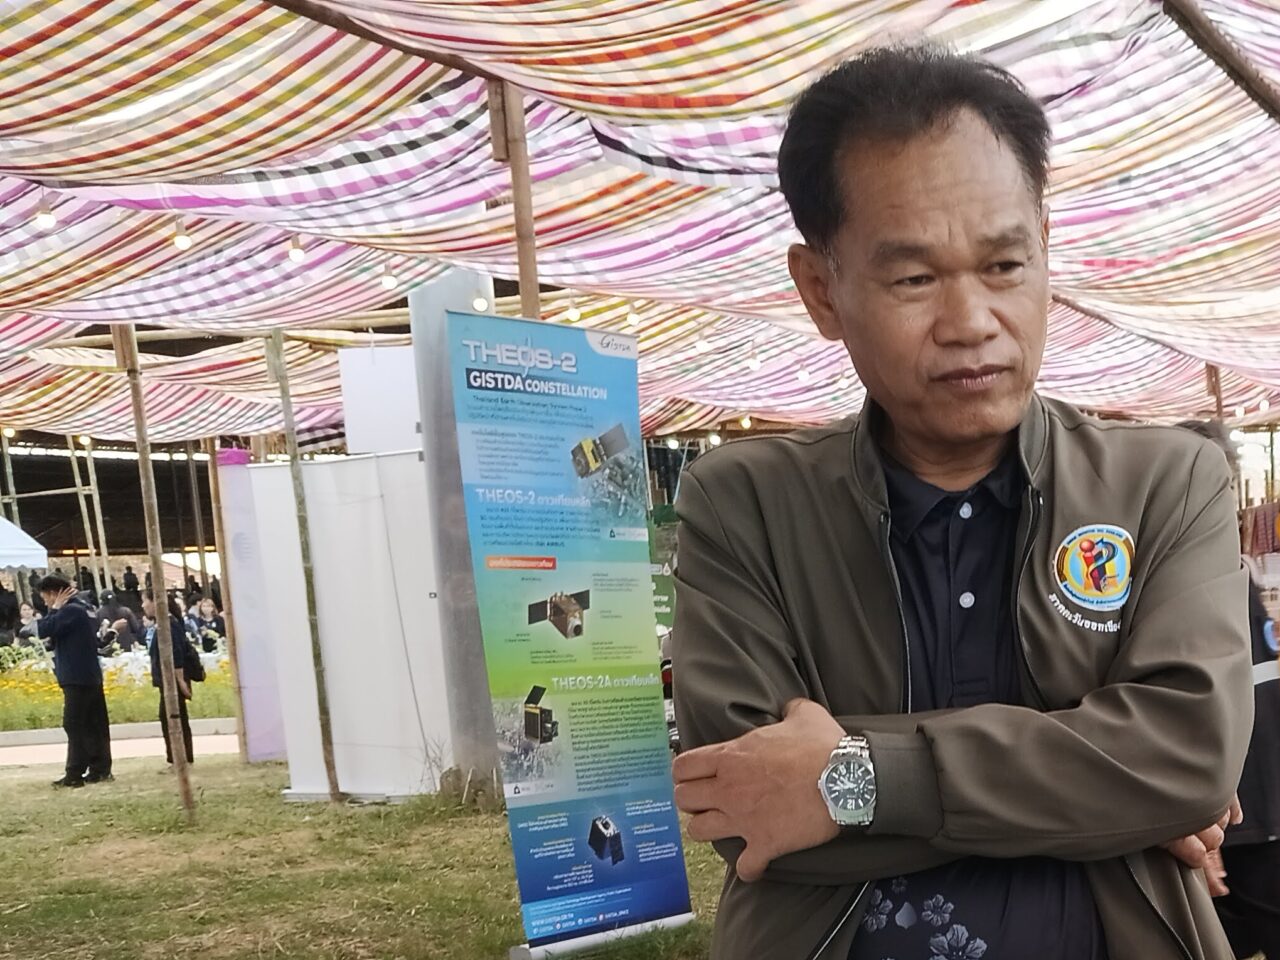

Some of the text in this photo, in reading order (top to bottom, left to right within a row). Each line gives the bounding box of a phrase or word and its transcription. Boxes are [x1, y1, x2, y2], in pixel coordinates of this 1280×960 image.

[462, 339, 578, 374] THEOS-2
[469, 371, 608, 399] GISTDA CONSTELLATION
[476, 488, 535, 504] THEOS-2
[552, 675, 612, 690] THEOS-2A
